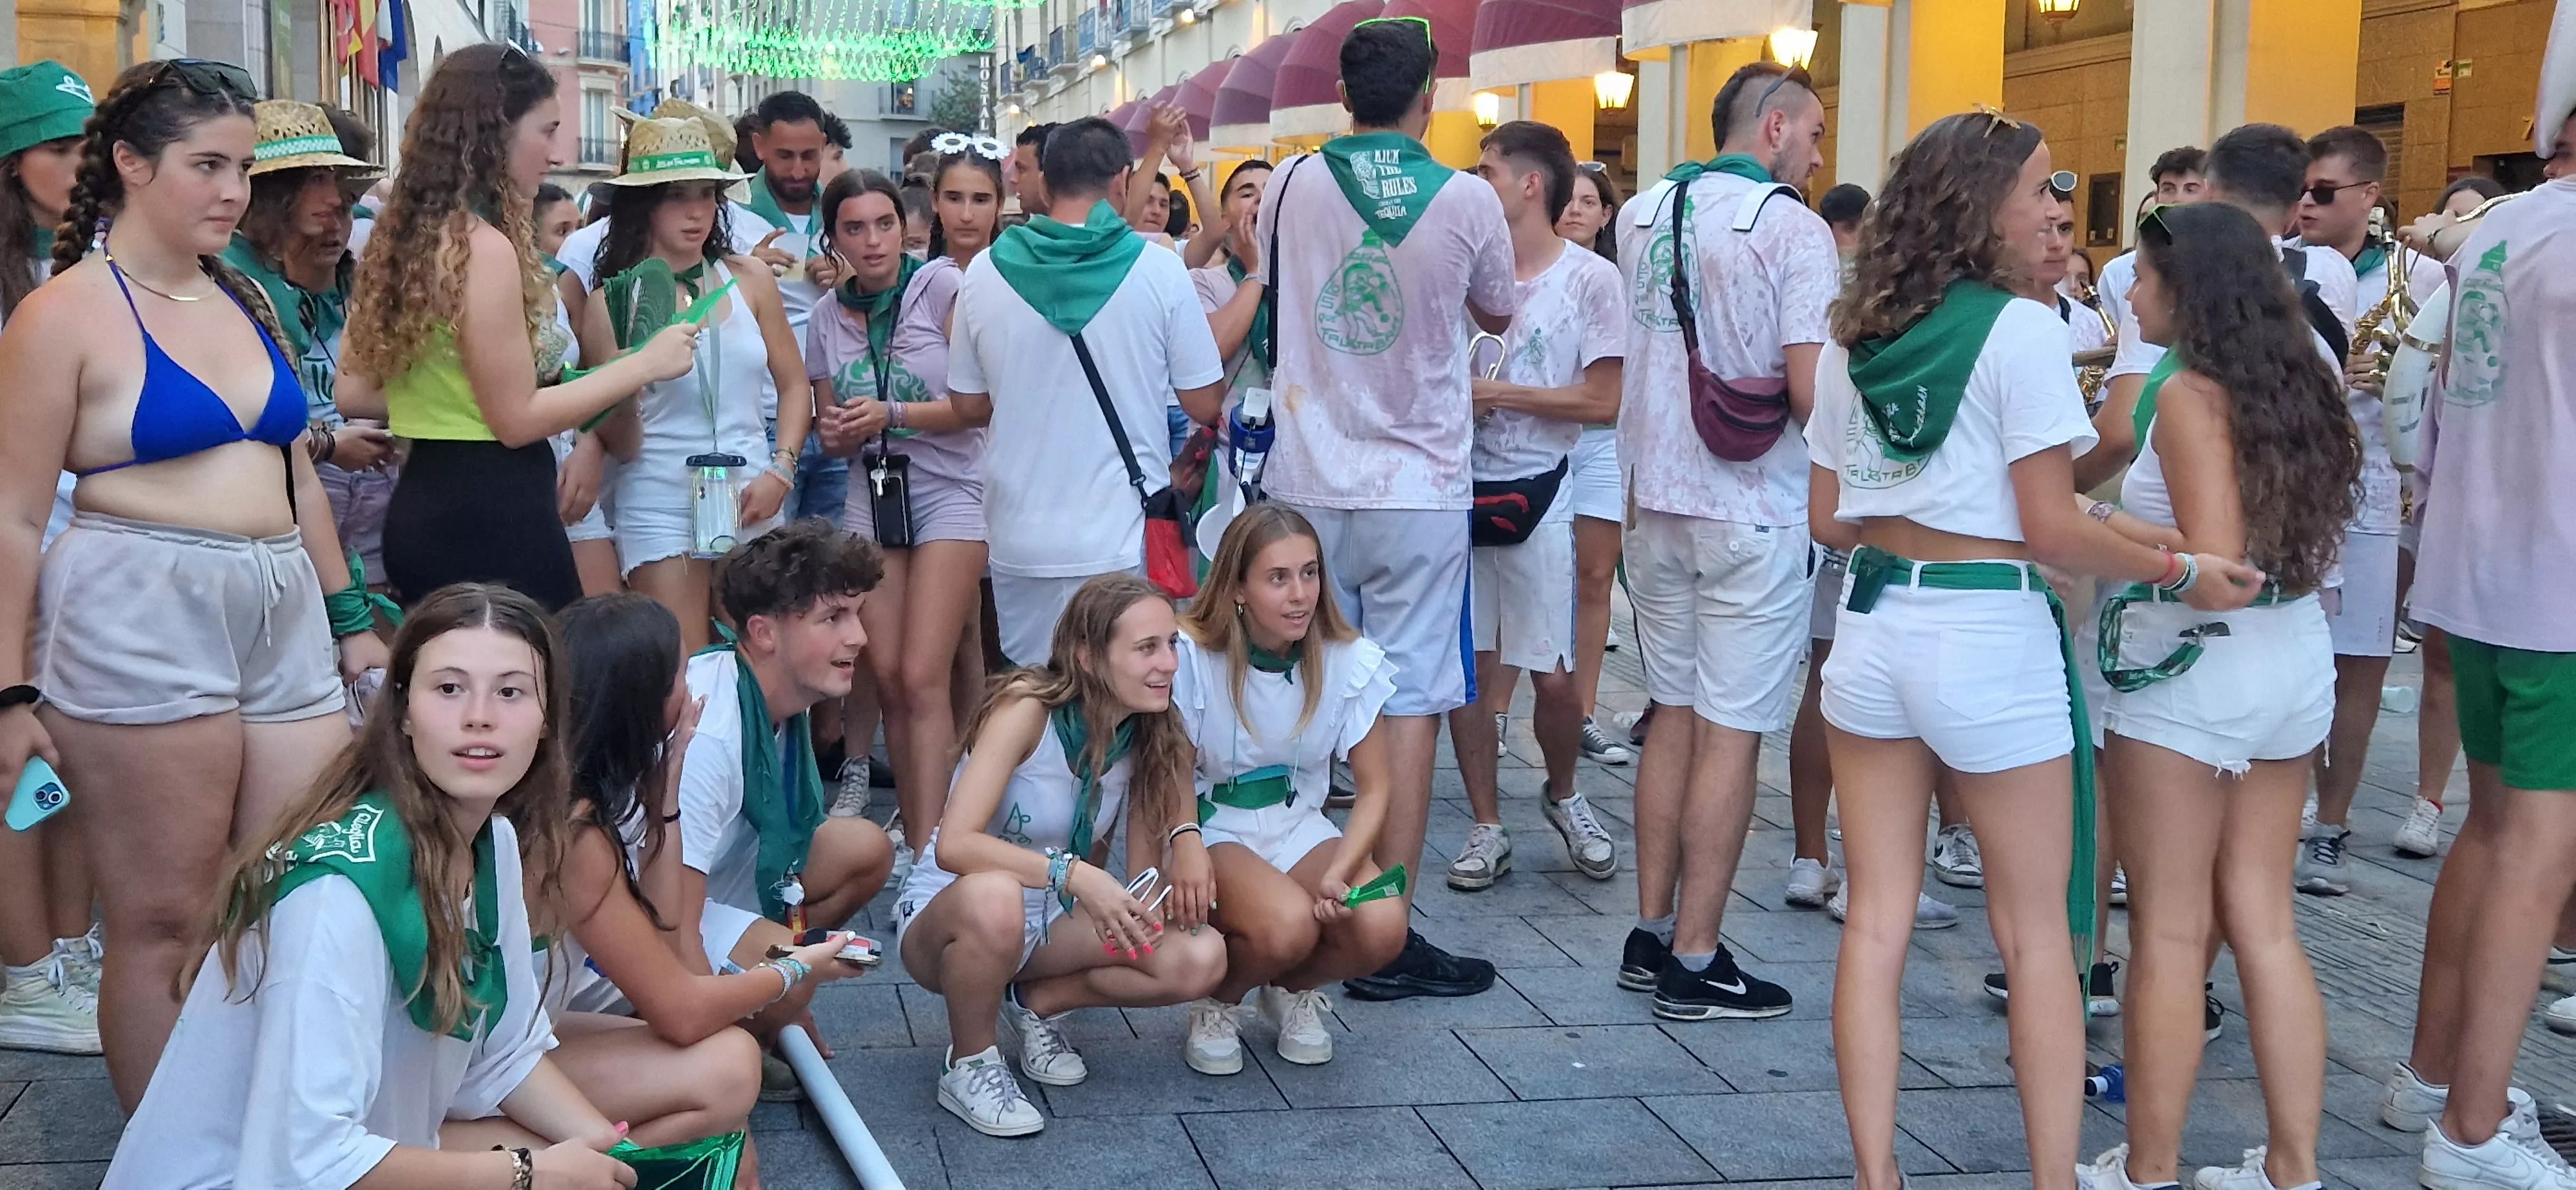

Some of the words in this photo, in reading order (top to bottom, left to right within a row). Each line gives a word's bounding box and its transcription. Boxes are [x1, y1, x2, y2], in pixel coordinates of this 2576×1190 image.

[980, 56, 990, 130] HOSTAL
[1381, 176, 1417, 198] RULES
[1374, 205, 1407, 219] TEQUILA
